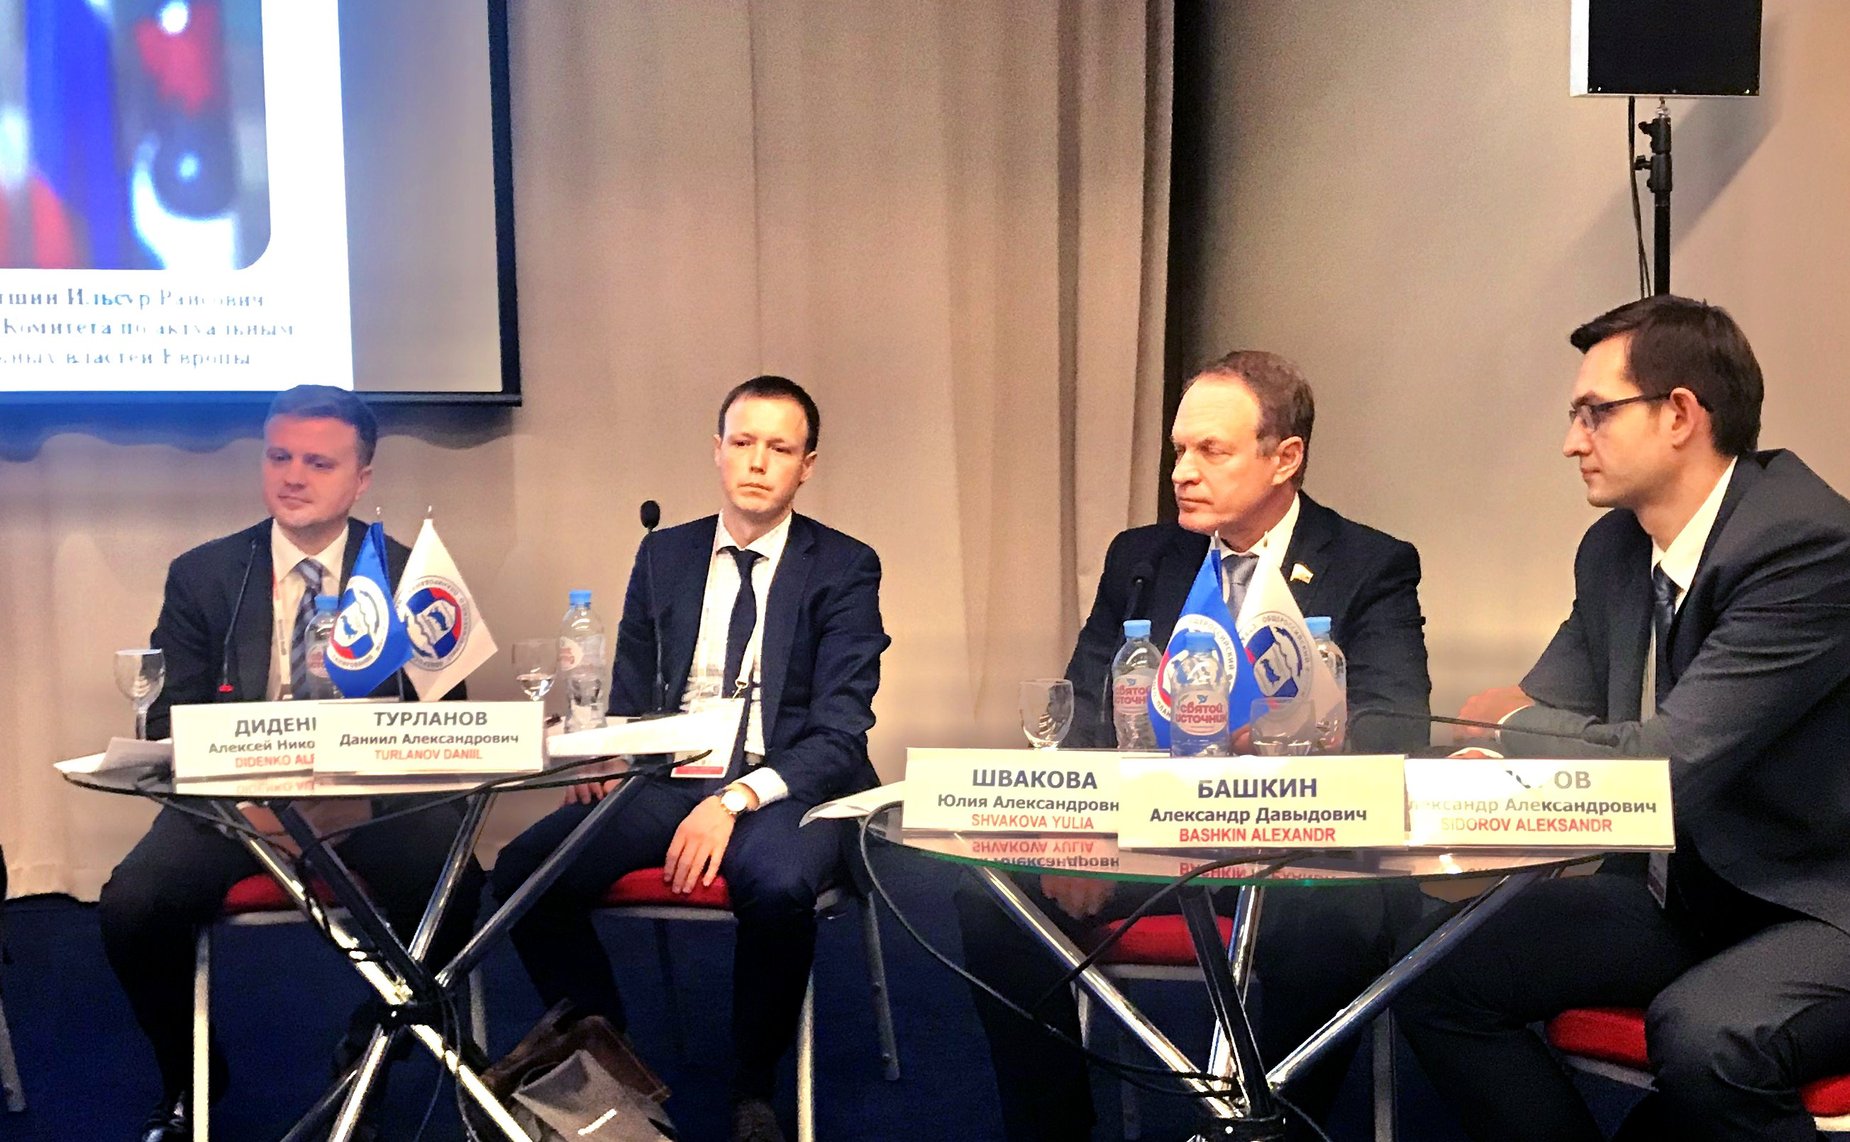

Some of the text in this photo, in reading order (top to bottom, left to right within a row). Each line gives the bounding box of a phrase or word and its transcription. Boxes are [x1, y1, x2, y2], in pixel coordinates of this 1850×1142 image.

[0, 293, 58, 305] шин
[234, 716, 317, 738] ДИДЕН
[374, 711, 488, 727] ТУРЛАНОВ
[208, 739, 316, 754] Алексей Нико
[339, 732, 519, 747] Даниил Александрович
[235, 755, 291, 768] DIDENKO
[374, 748, 483, 761] TURLANOV DANIIL
[971, 769, 1098, 790] ШВАКОВА
[1197, 778, 1317, 799] БАШКИН
[937, 794, 1119, 814] Юлия Александровн
[1505, 798, 1657, 815] Александрович
[971, 813, 1094, 830] SHVAKOVA YULIA
[1150, 807, 1367, 824] Александр Давыдович
[1441, 817, 1613, 832] SIDOROV ALEKSANDR
[1179, 827, 1336, 842] BASHKIN ALEXANDR
